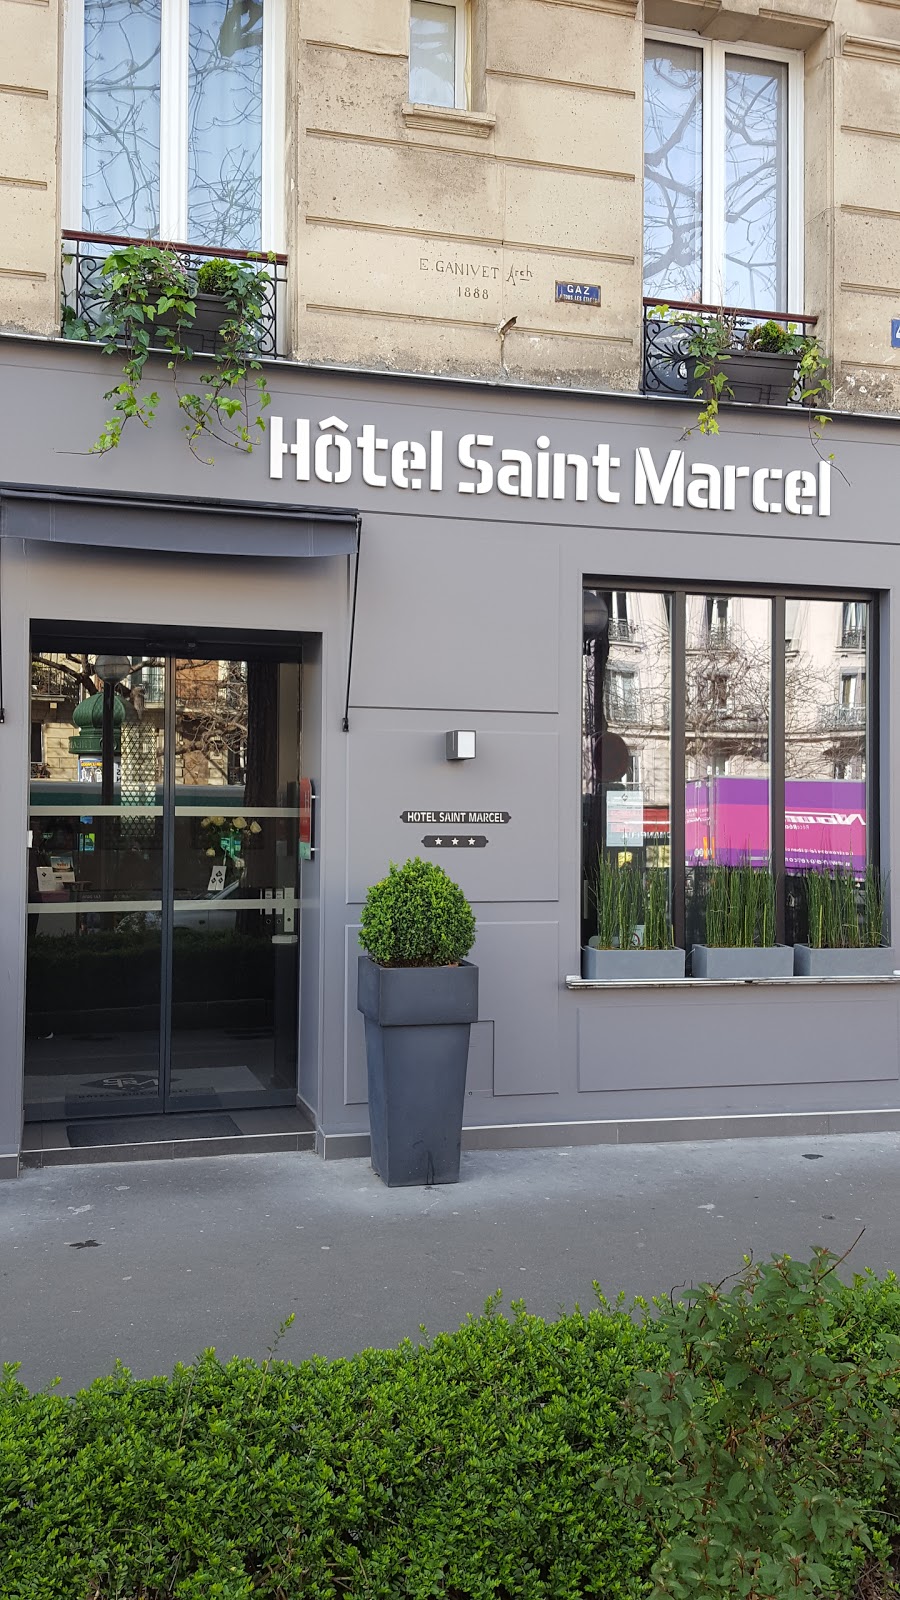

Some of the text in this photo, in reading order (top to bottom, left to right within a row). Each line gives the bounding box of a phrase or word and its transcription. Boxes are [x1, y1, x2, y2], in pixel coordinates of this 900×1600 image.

[457, 286, 489, 300] 1888
[567, 284, 590, 295] GAZ
[269, 415, 832, 517] Hôtel Saint Marcel
[407, 811, 505, 823] HOTEL SAINT MARCEL
